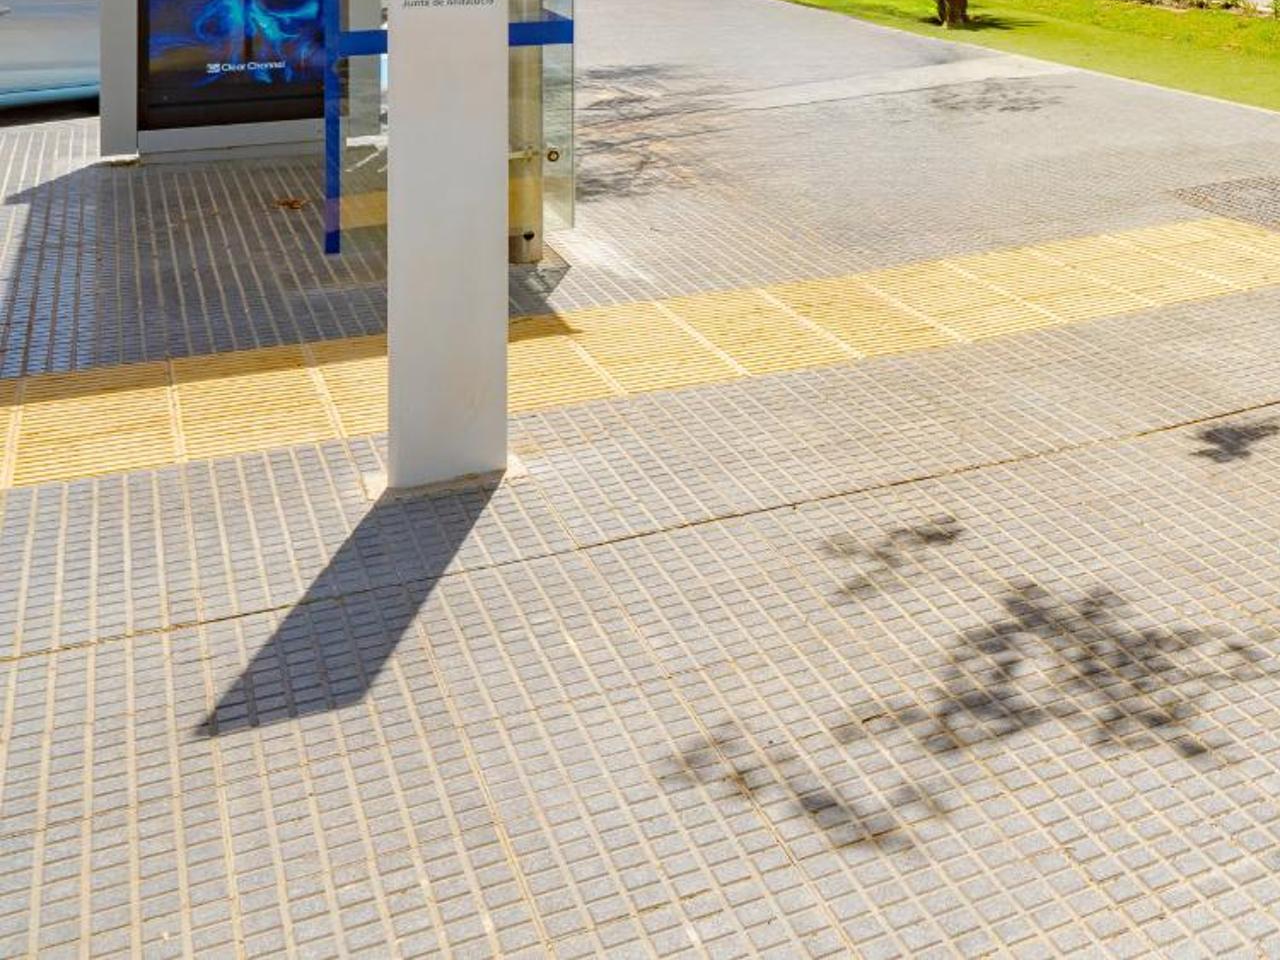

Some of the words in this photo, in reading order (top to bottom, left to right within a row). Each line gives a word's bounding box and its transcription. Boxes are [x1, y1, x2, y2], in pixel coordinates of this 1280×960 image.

[402, 0, 430, 8] Junta
[221, 62, 246, 72] Clear
[247, 61, 287, 71] Channel
